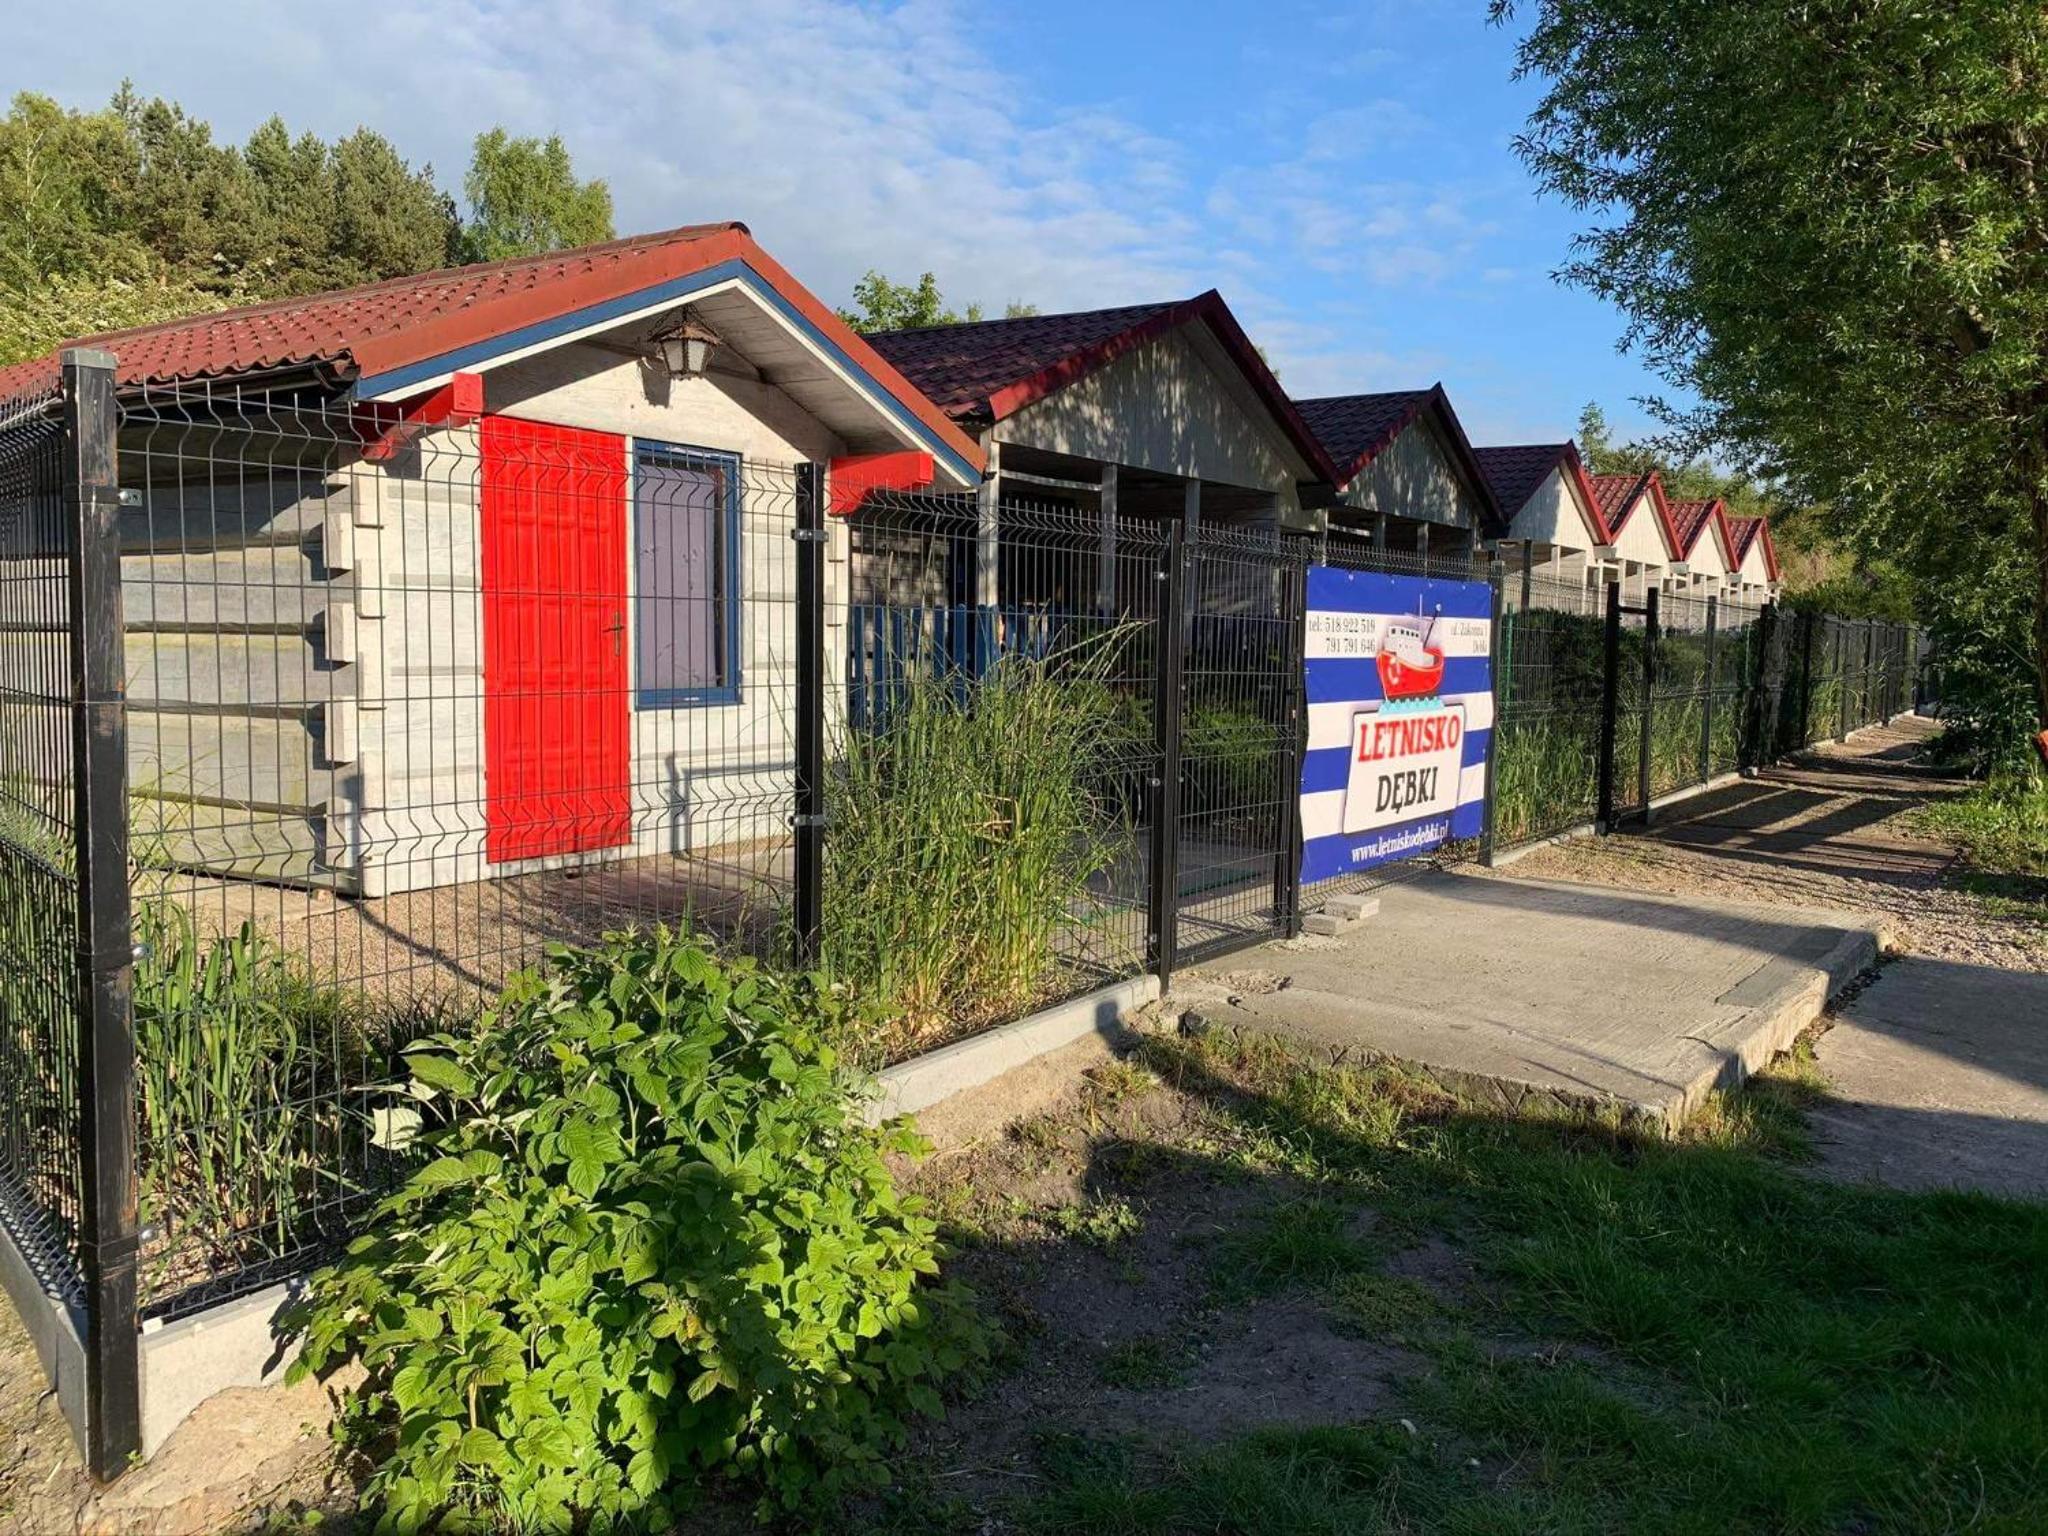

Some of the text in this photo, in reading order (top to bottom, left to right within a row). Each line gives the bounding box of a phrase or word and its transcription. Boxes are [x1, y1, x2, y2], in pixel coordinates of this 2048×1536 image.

[1308, 615, 1376, 635] tel: 518 922 519
[1325, 637, 1341, 653] 791
[1343, 638, 1359, 653] 791
[1358, 715, 1461, 762] LETNISKO
[1375, 766, 1438, 814] DĘBKI
